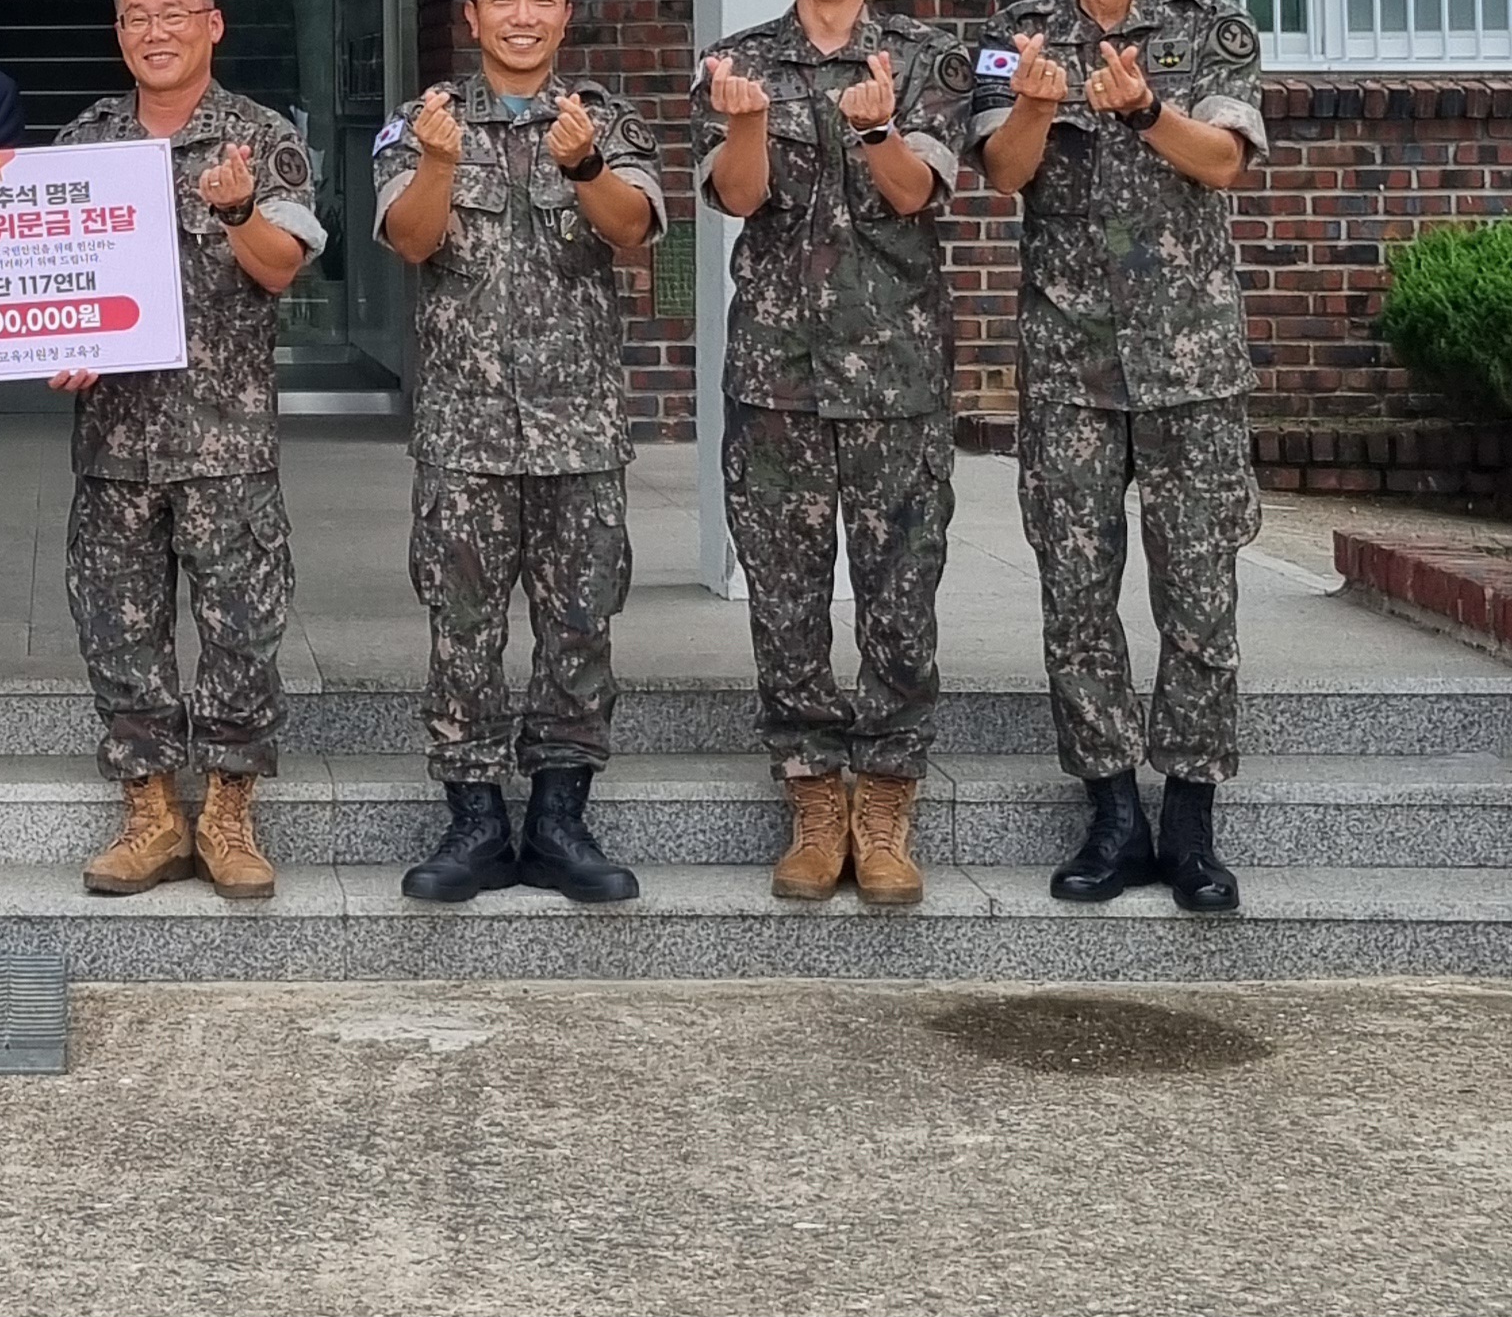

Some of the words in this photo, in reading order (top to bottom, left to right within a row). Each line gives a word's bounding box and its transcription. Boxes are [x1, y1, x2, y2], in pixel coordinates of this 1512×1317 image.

[45, 181, 91, 206] 명절
[80, 205, 137, 234] 전달
[18, 270, 96, 295] 117연대
[64, 344, 101, 359] 교육장
